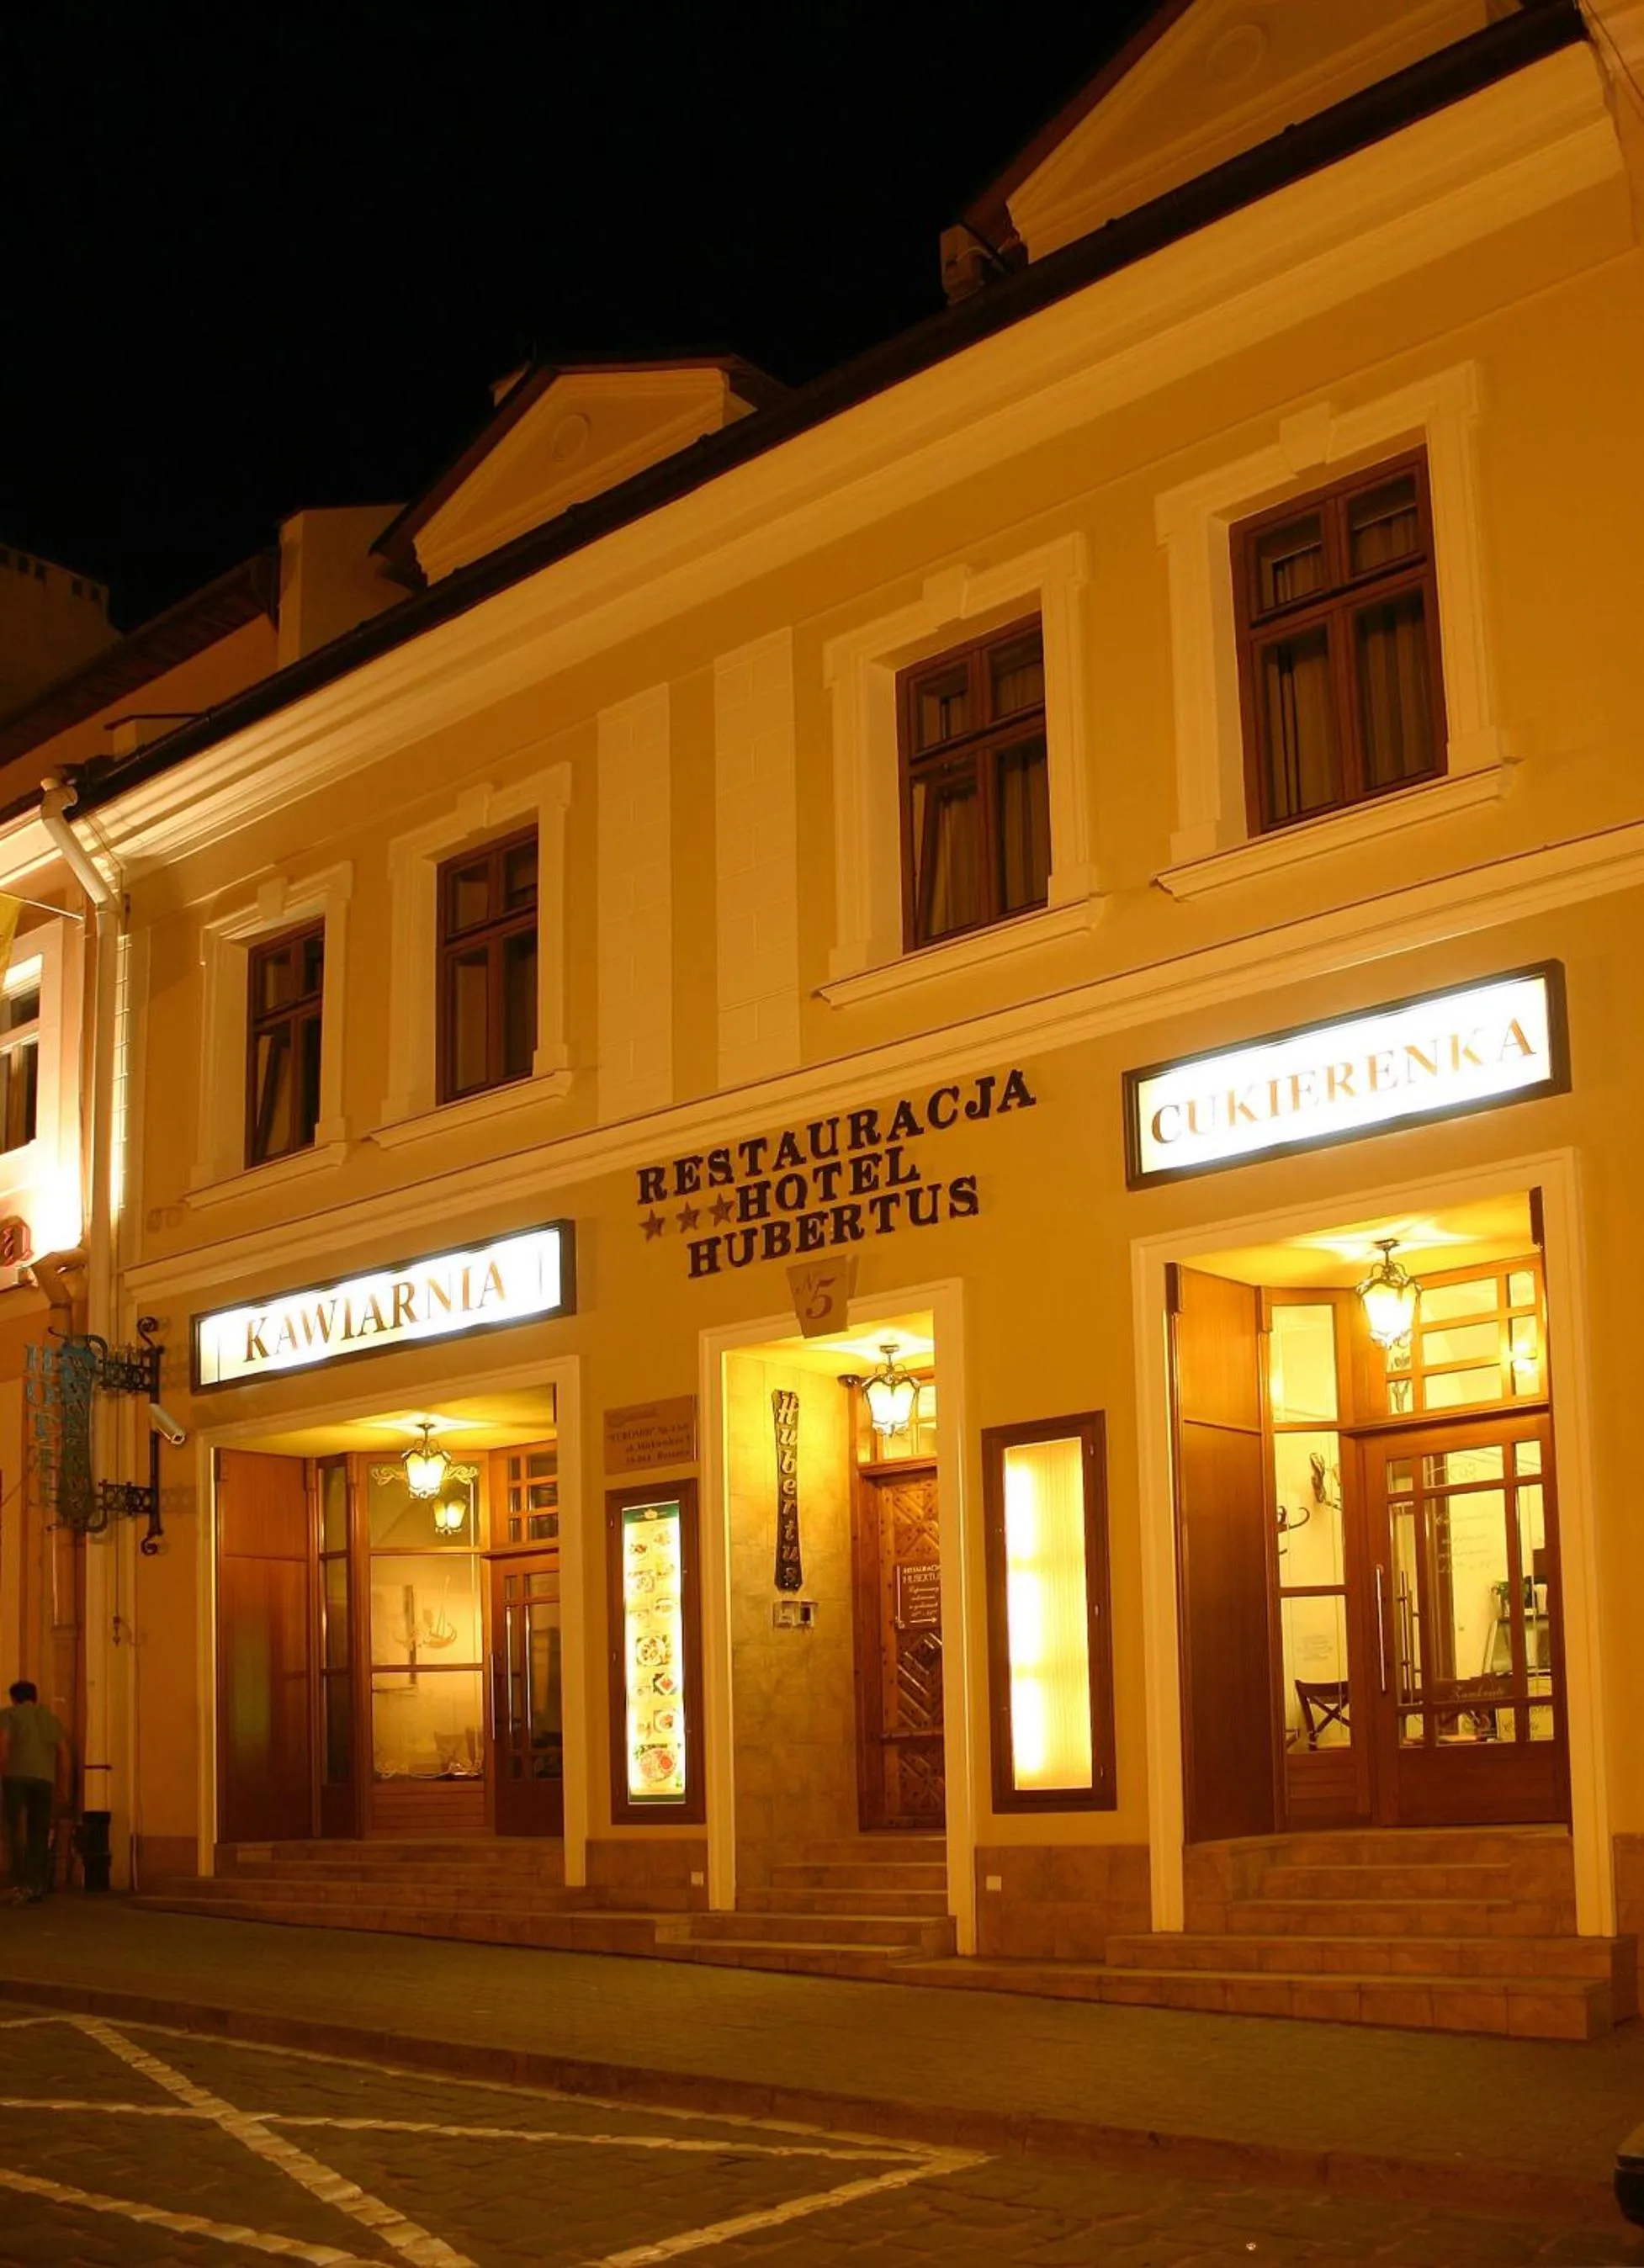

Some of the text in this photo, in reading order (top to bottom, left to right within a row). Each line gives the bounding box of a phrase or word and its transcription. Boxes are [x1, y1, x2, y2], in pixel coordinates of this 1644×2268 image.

[637, 1069, 1037, 1205] RESTAURACJA
[1150, 1017, 1537, 1145] CUKIERENKA
[687, 1175, 979, 1280] HUBERTUS
[735, 1145, 921, 1222] HOTEL
[242, 1259, 506, 1364] KAWIARNIA
[777, 1392, 799, 1582] Hubertus
